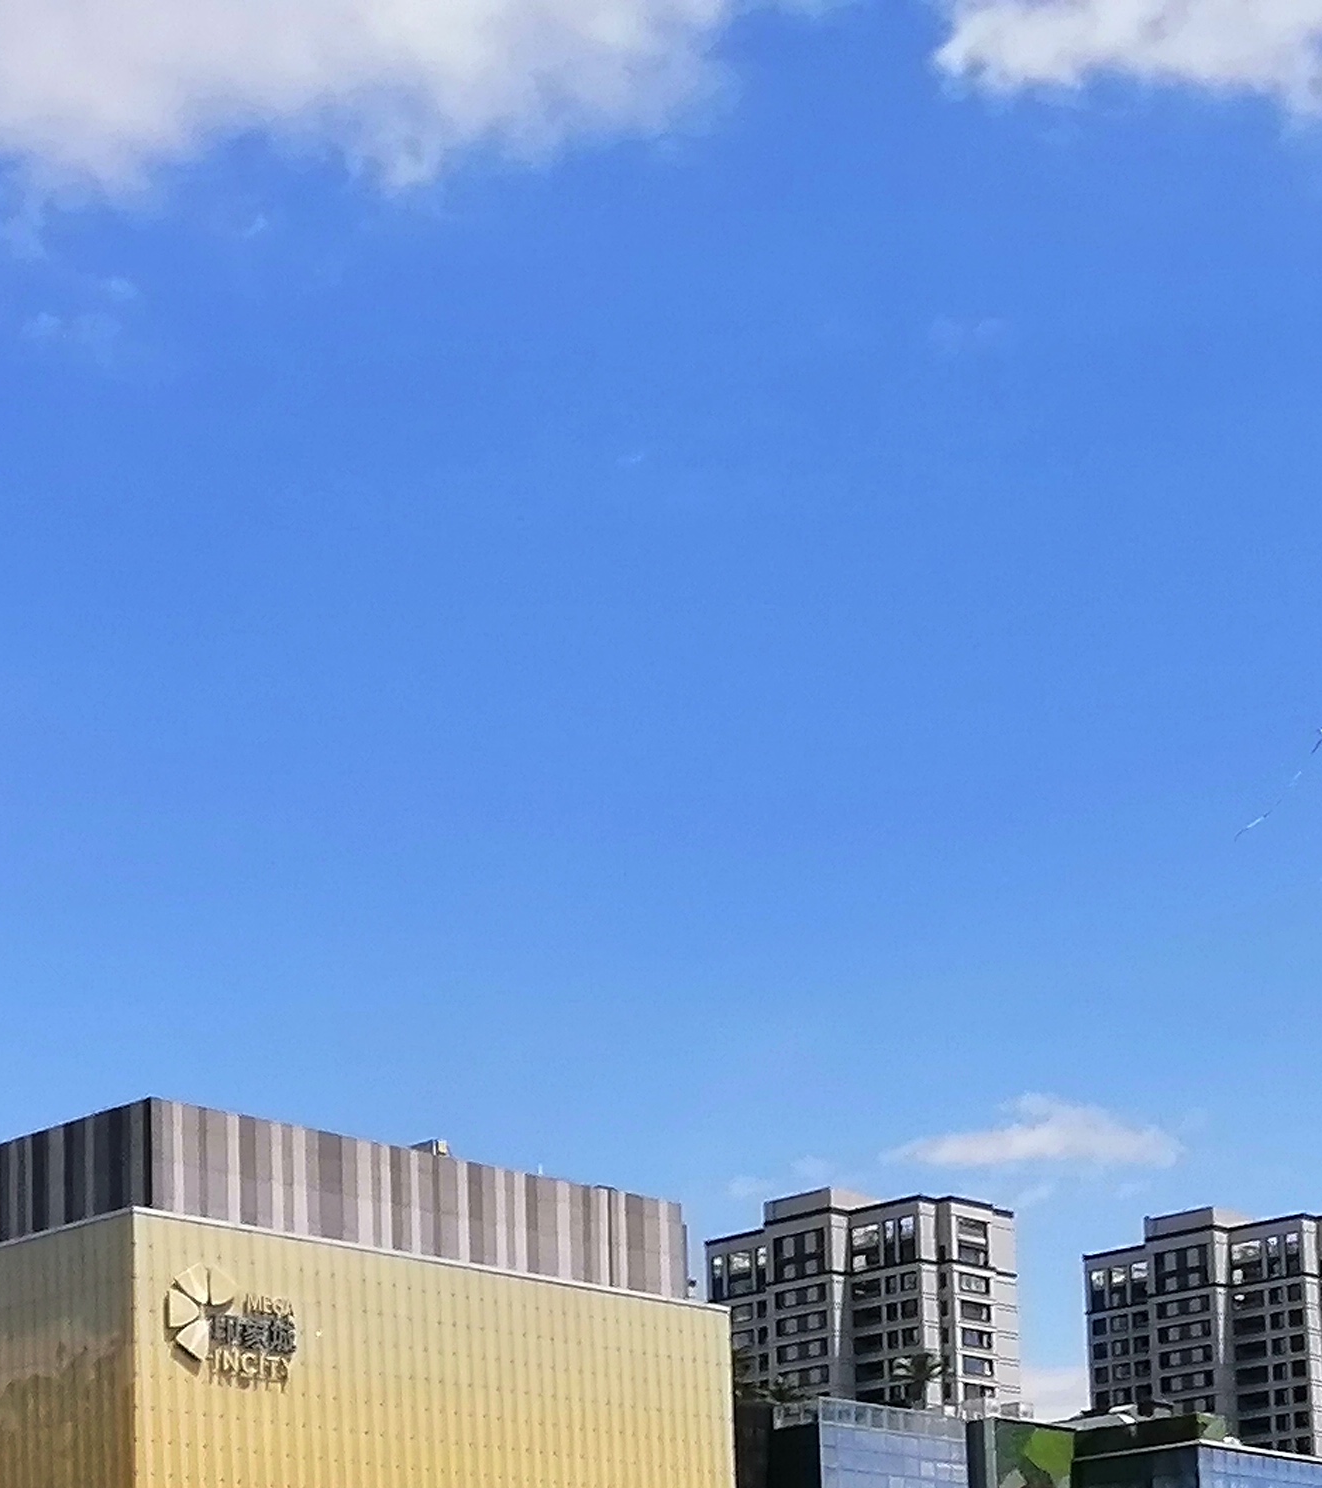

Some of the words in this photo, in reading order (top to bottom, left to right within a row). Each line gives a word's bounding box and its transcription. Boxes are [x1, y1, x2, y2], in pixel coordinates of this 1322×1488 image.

[243, 1294, 294, 1317] MEGA
[209, 1315, 295, 1354] 印象城
[214, 1347, 289, 1380] INCITY
